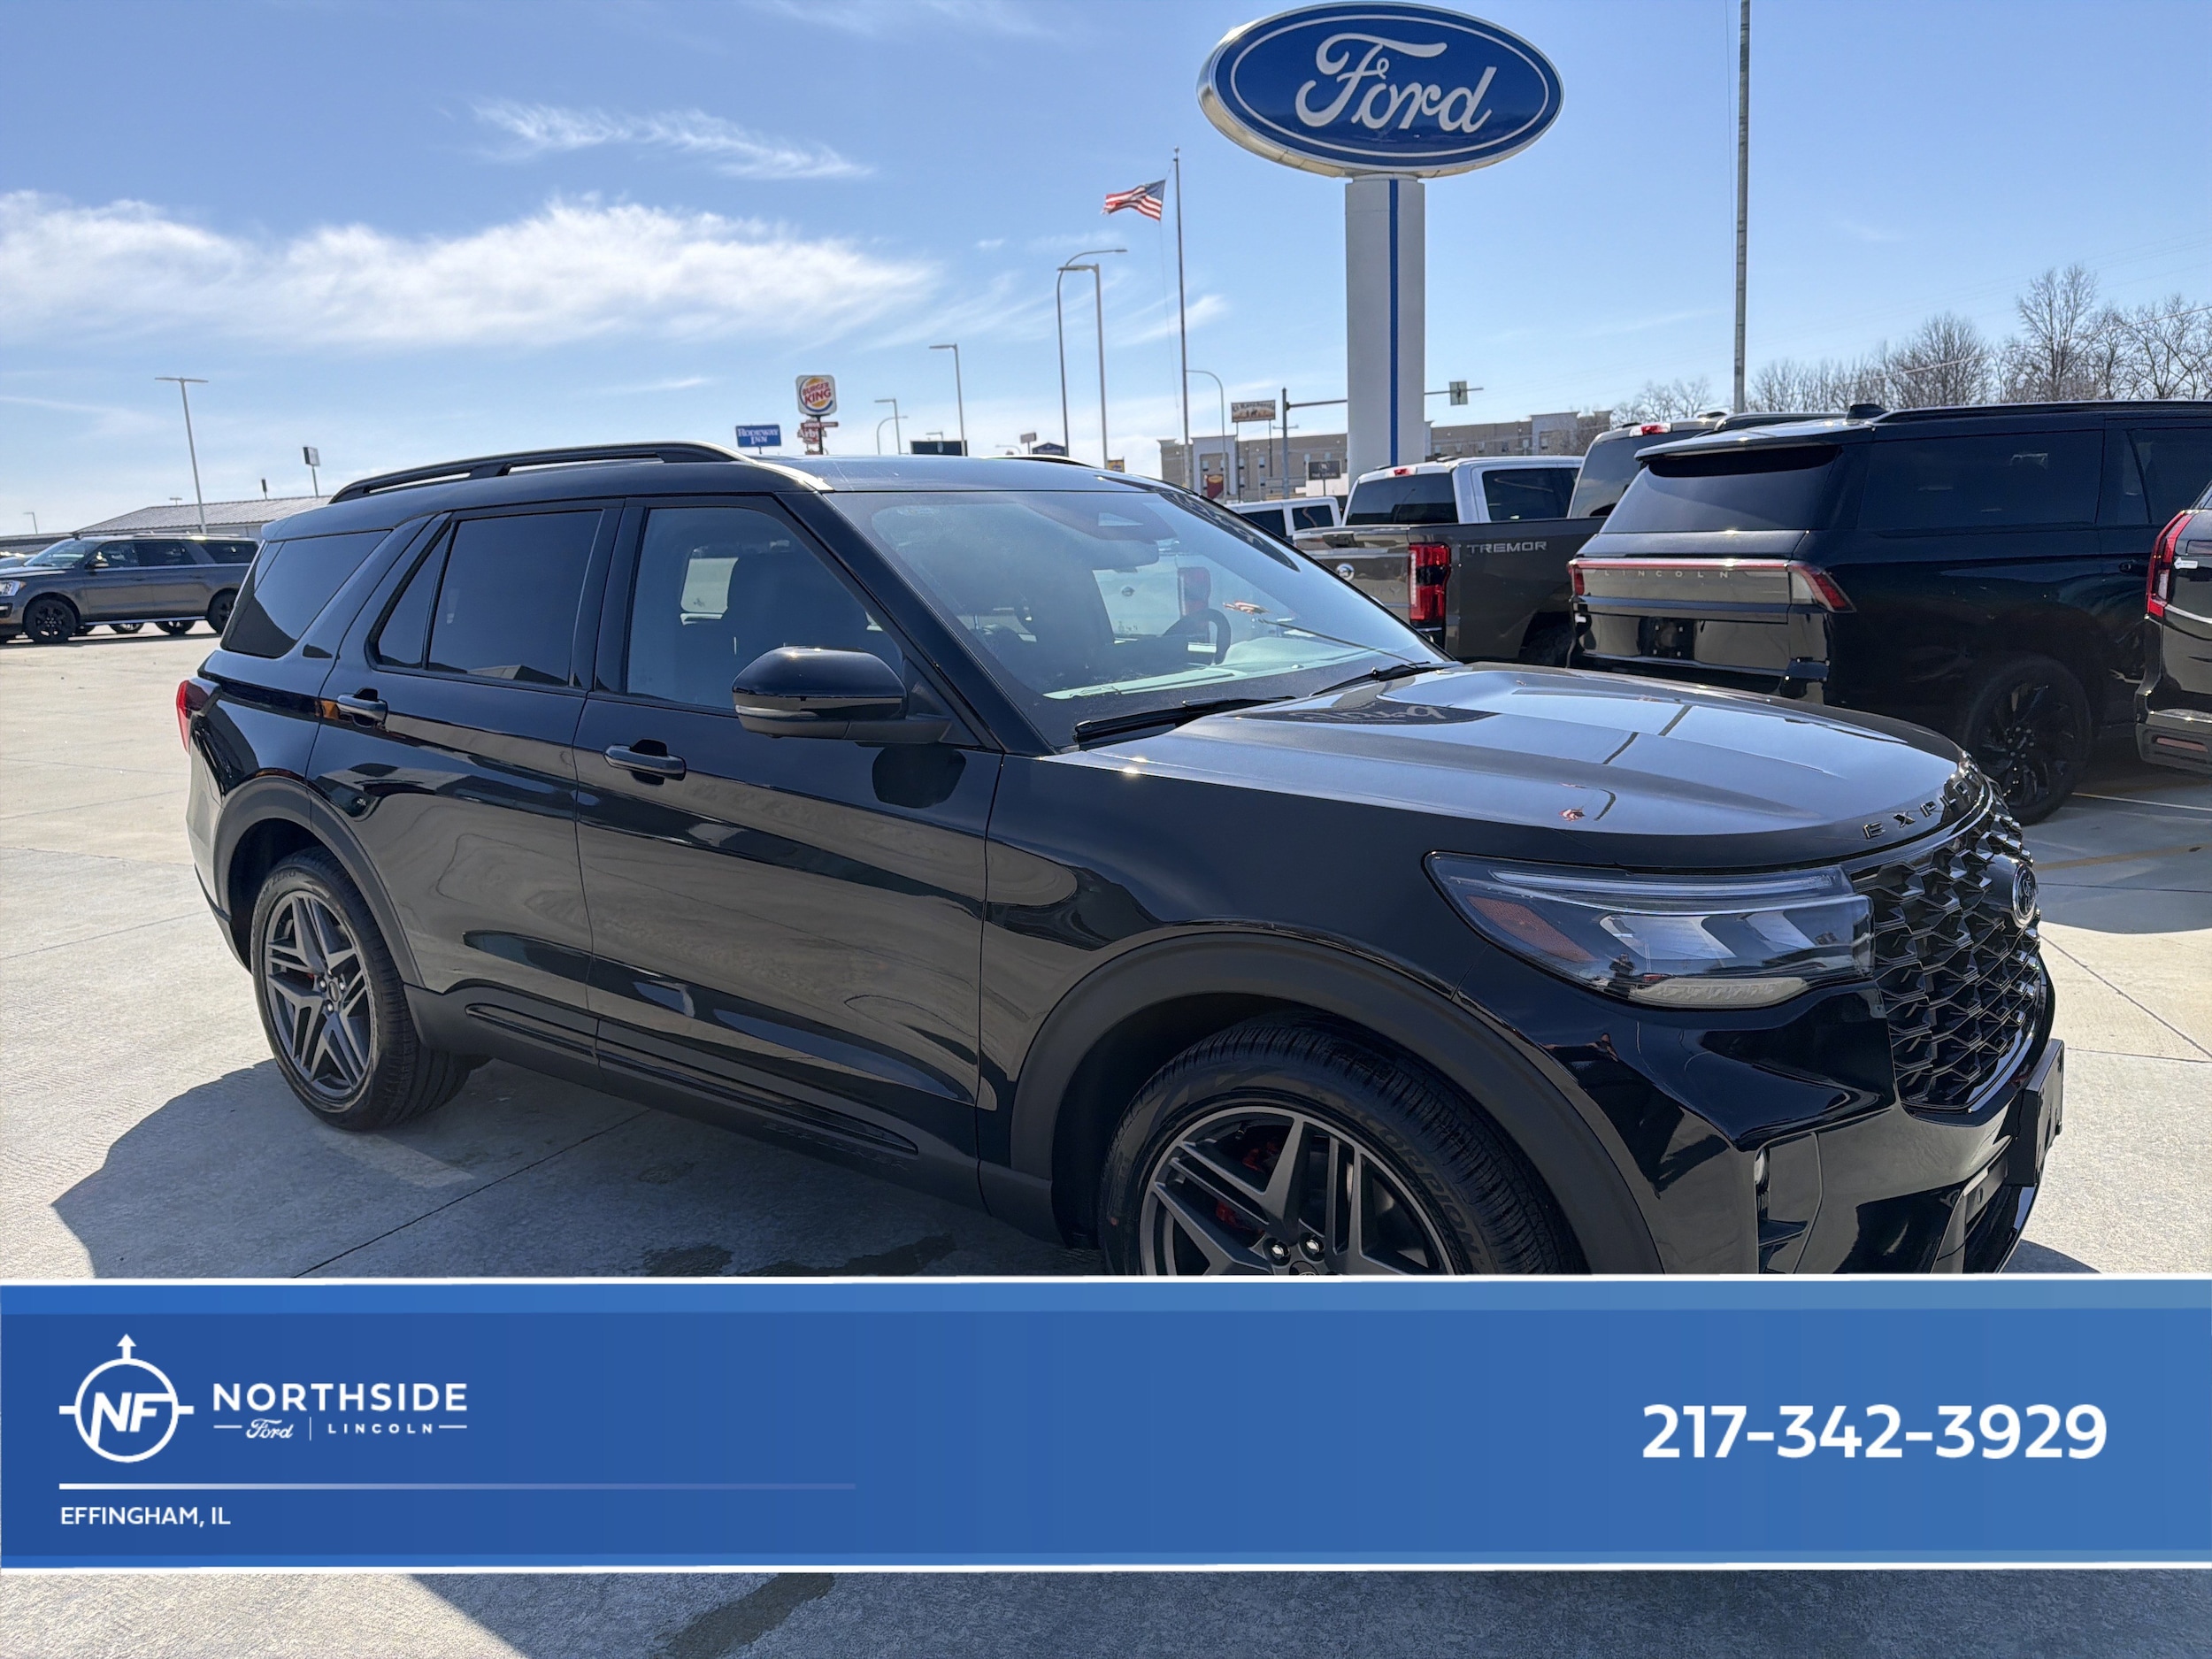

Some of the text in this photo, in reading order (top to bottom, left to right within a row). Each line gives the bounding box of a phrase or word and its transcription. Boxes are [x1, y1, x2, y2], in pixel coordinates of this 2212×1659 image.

[1294, 33, 1498, 133] Ford
[803, 382, 829, 396] BURGER
[804, 389, 832, 405] KING
[738, 428, 779, 437] RODEWAY
[1467, 541, 1548, 554] TREMOR
